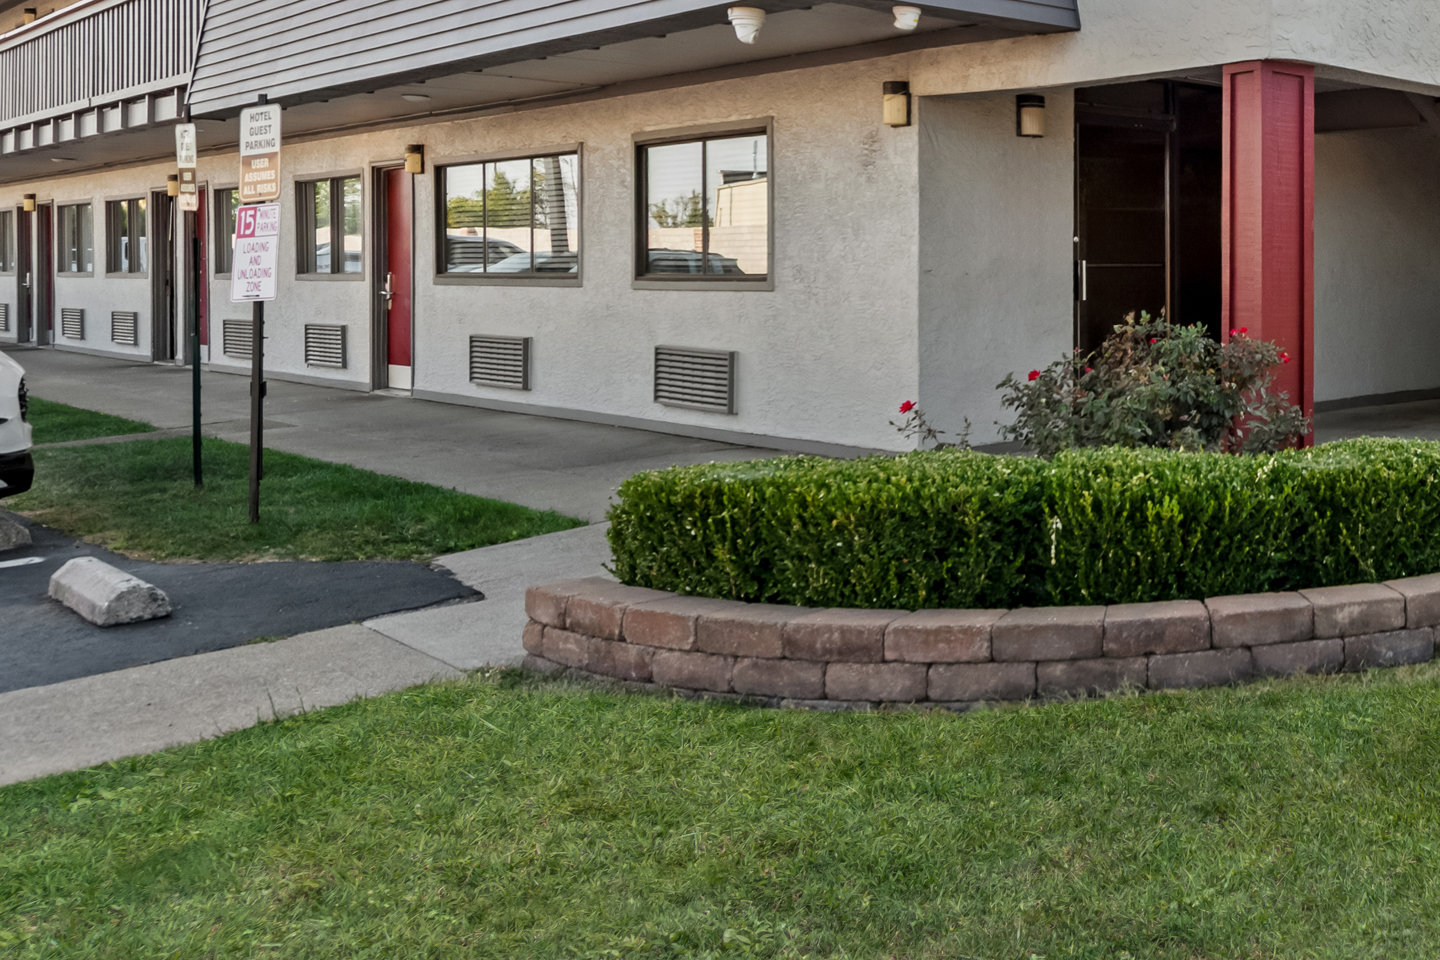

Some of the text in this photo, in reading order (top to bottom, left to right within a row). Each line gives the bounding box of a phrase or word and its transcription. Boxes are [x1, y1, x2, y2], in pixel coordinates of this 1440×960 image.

[249, 111, 272, 123] HOTEL
[249, 124, 272, 137] GUEST
[245, 138, 276, 150] PARKING
[251, 157, 269, 169] USER
[244, 170, 276, 182] ASSUMES
[243, 182, 277, 195] ALL RISKS
[258, 208, 277, 220] MINUTE
[240, 209, 255, 235] 15
[256, 221, 278, 233] PARKING
[242, 241, 270, 254] LOADING
[249, 255, 262, 266] AND
[237, 267, 272, 280] UNLOADING
[246, 281, 262, 292] ZONE
